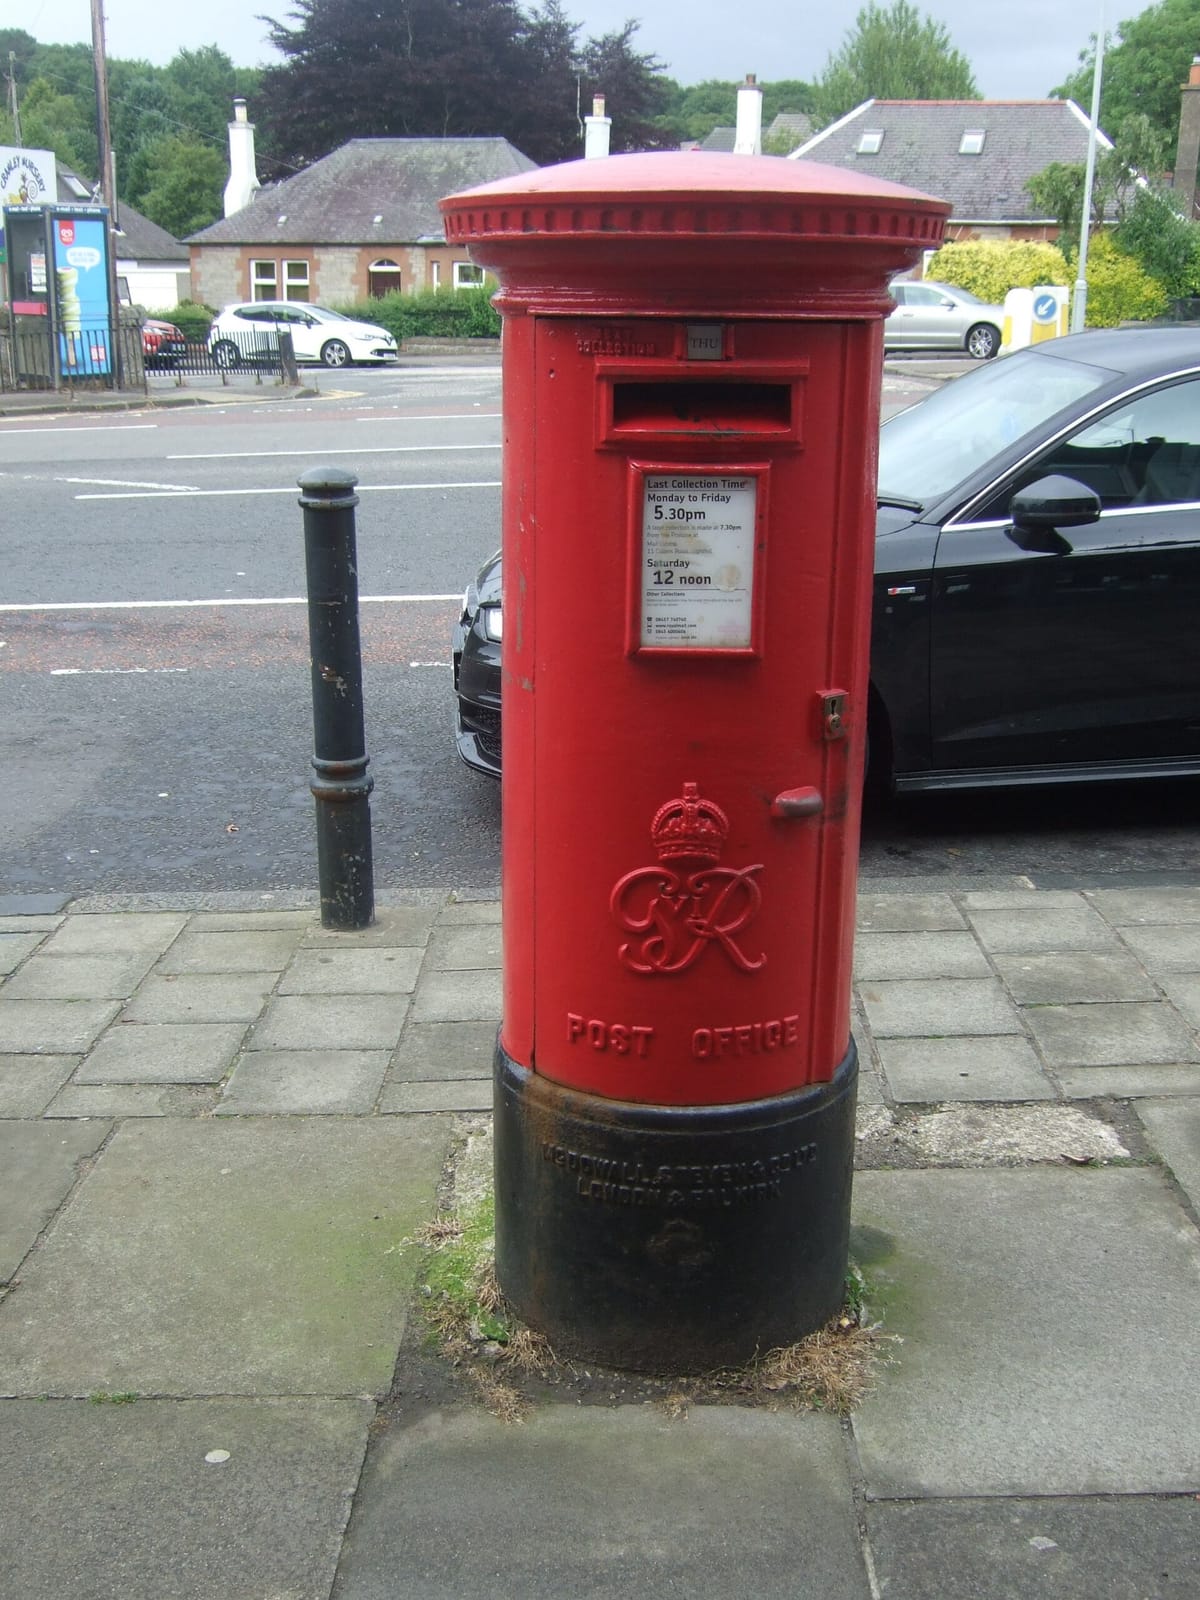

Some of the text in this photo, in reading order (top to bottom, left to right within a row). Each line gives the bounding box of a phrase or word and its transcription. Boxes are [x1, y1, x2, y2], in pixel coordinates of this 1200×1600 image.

[576, 338, 656, 356] COLLECTION
[690, 337, 719, 349] THU
[647, 480, 668, 489] Last
[671, 480, 718, 489] Collection
[647, 493, 731, 503] Monday to Friday
[654, 505, 706, 522] 5.30pm
[647, 559, 690, 568] Saturday
[653, 570, 712, 585] 12 noon
[567, 1012, 800, 1058] POST OFFICE
